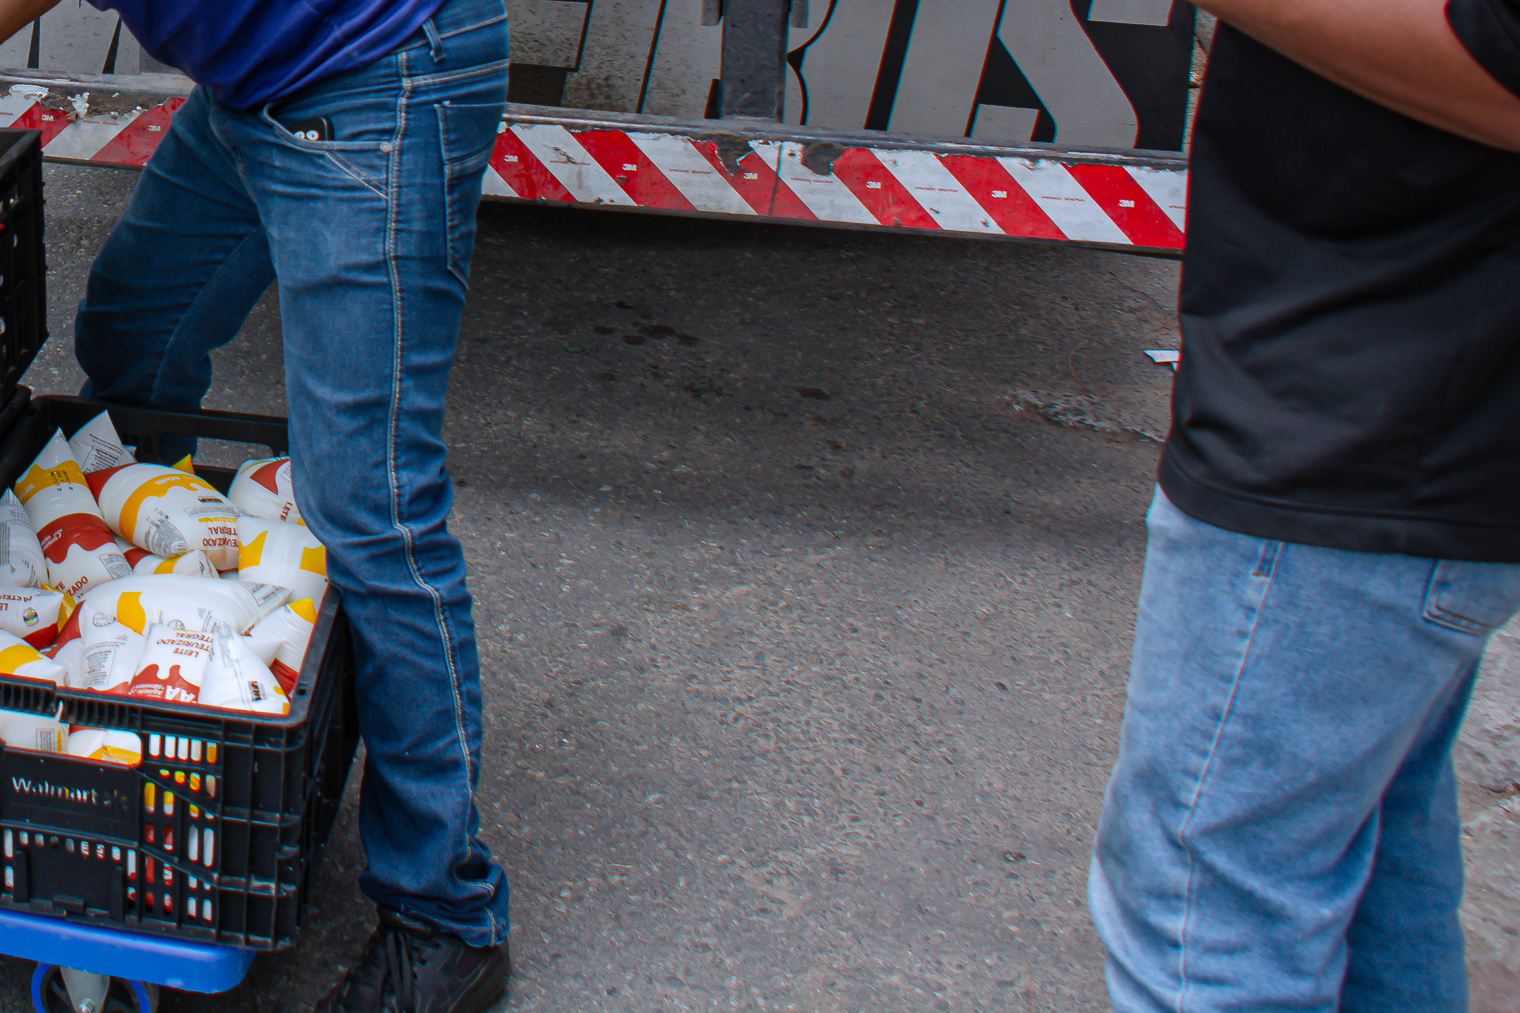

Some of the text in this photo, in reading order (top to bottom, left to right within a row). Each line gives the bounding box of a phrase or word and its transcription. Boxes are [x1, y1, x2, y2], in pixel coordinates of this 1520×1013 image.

[41, 114, 54, 122] 3M
[504, 154, 518, 163] 3M
[622, 163, 637, 171] 3M
[743, 172, 758, 180] 3M
[866, 181, 881, 189] 3M
[991, 190, 1007, 198] 3M
[1119, 199, 1135, 208] 3M
[156, 638, 210, 652] TEURIZADO
[172, 647, 200, 658] LEITE
[165, 684, 198, 703] AA
[11, 776, 98, 805] Walmart
